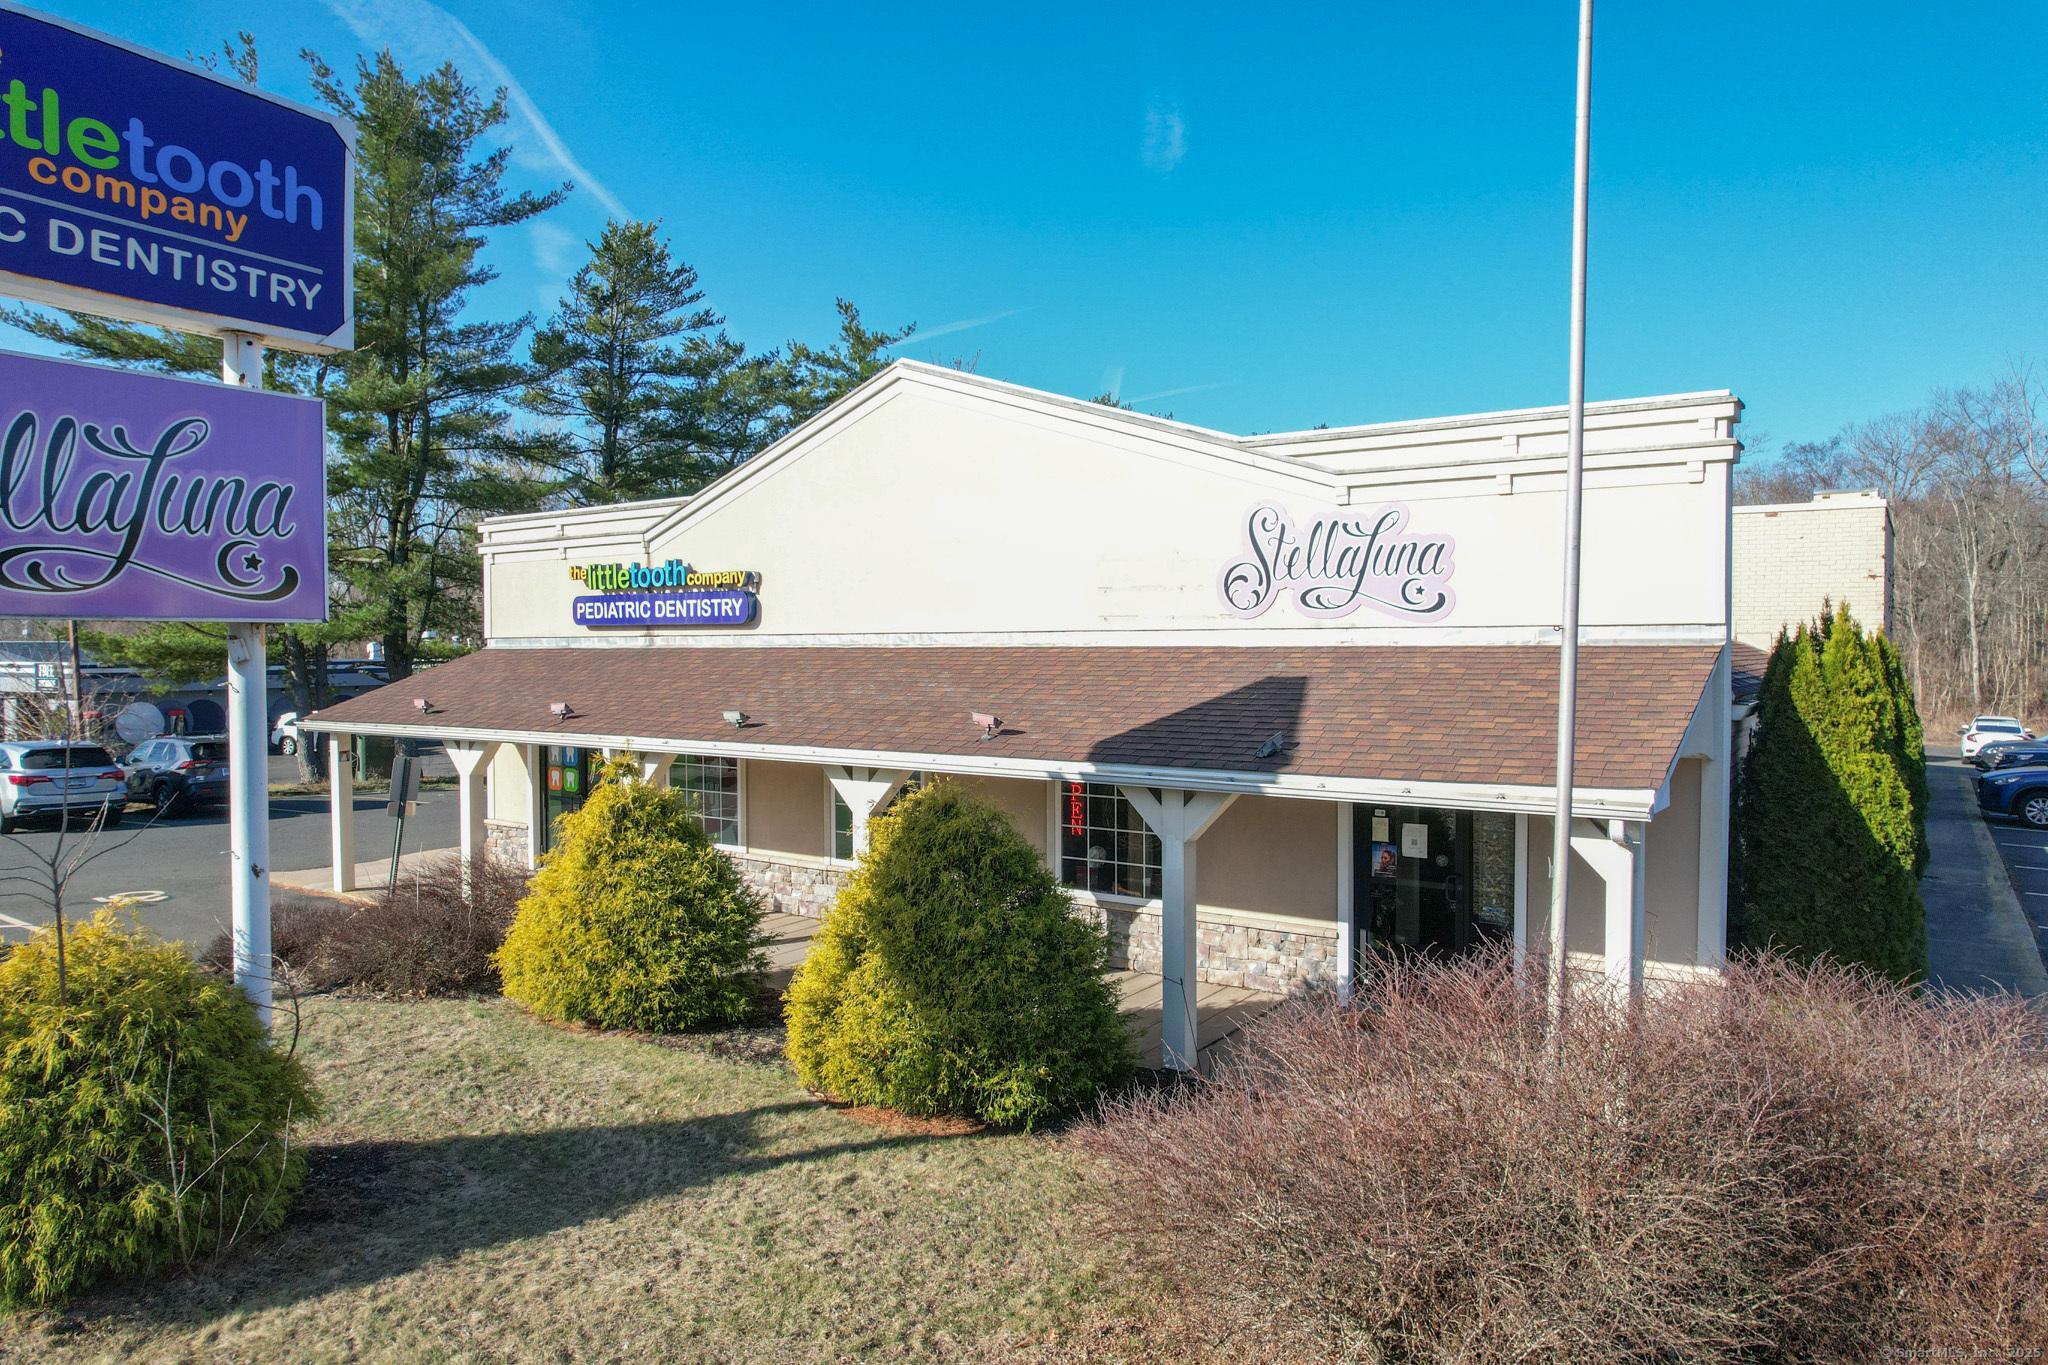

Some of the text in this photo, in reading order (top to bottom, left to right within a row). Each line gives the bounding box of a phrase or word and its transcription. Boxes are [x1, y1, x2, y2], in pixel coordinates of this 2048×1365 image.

[28, 157, 248, 242] company
[49, 218, 322, 311] DENTISTRY
[569, 566, 587, 580] the
[686, 571, 746, 588] company
[576, 598, 743, 620] PEDIATRIC DENTISTRY
[1070, 783, 1084, 836] PEN
